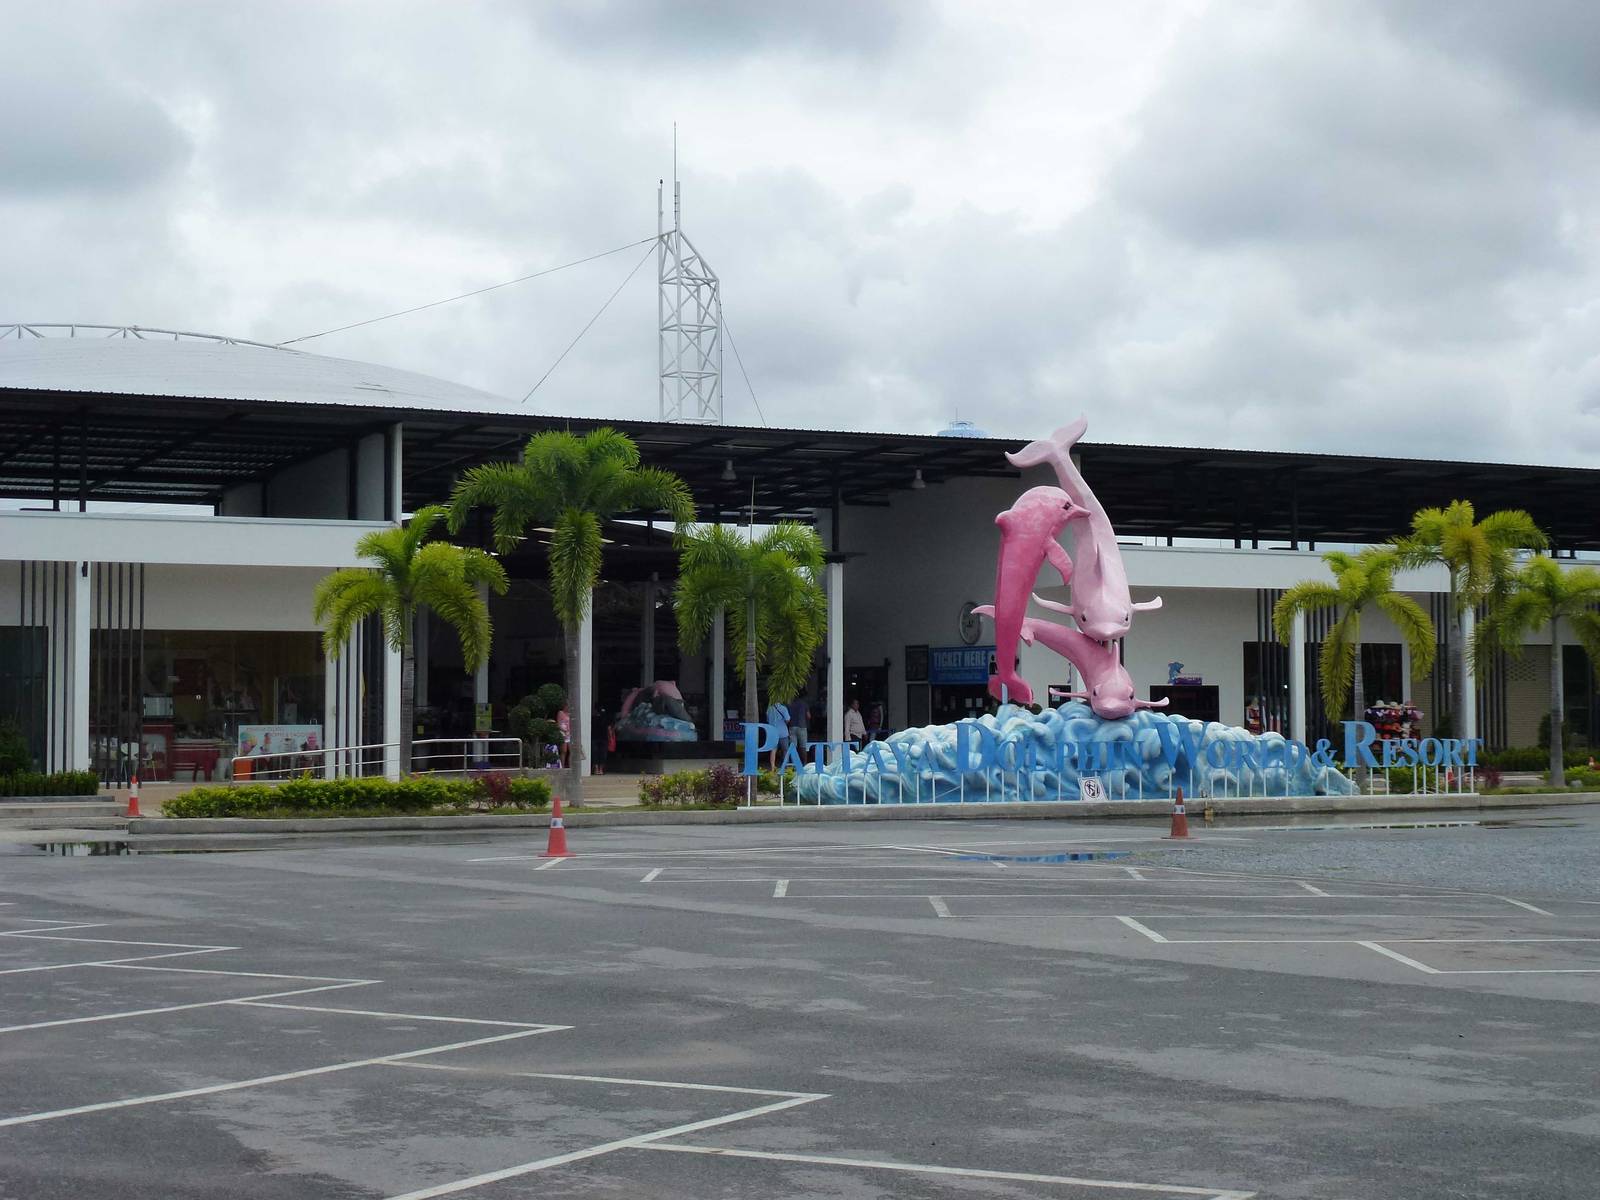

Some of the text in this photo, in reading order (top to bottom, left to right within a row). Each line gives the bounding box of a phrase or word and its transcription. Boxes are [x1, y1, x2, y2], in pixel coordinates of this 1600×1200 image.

[933, 650, 986, 667] TICKET HERE
[739, 720, 1484, 775] PATTAYA DOLPHIN WORLD & RESORT
